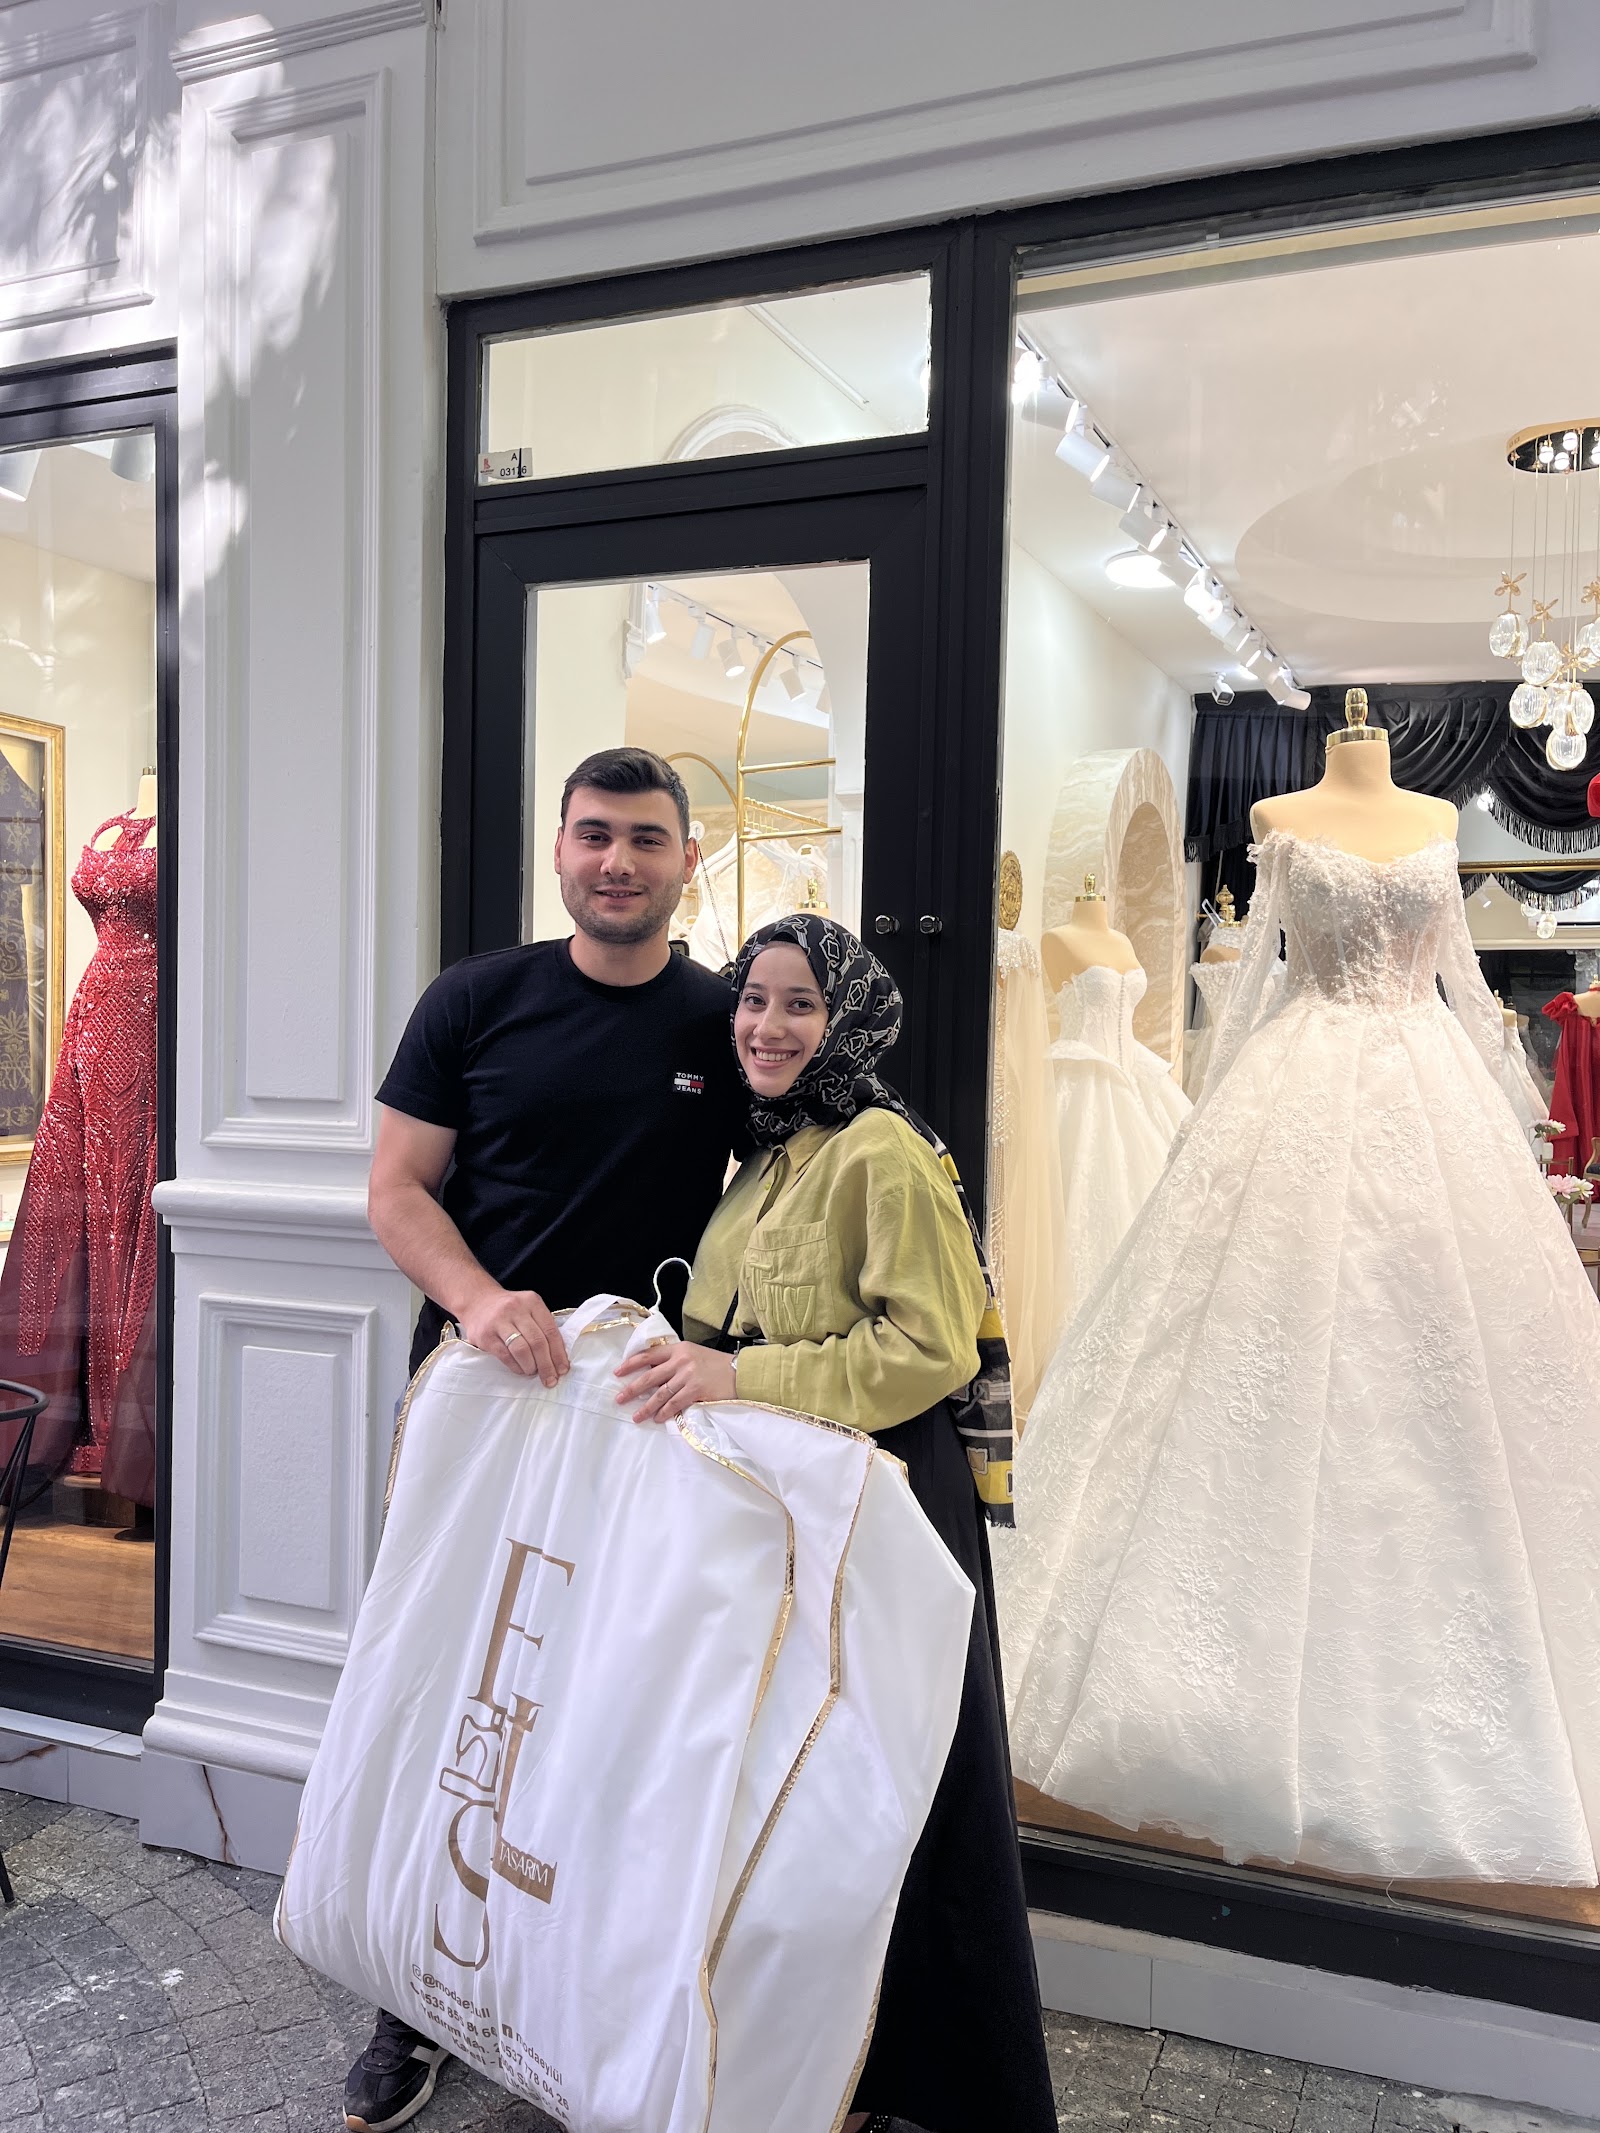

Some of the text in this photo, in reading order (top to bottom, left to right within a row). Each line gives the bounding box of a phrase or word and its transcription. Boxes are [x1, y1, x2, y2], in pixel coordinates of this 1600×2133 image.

[511, 452, 517, 461] A
[500, 466, 527, 477] 0316
[676, 1072, 704, 1081] TOMMY
[677, 1086, 702, 1095] JEANS
[500, 1841, 549, 1887] TASARIM
